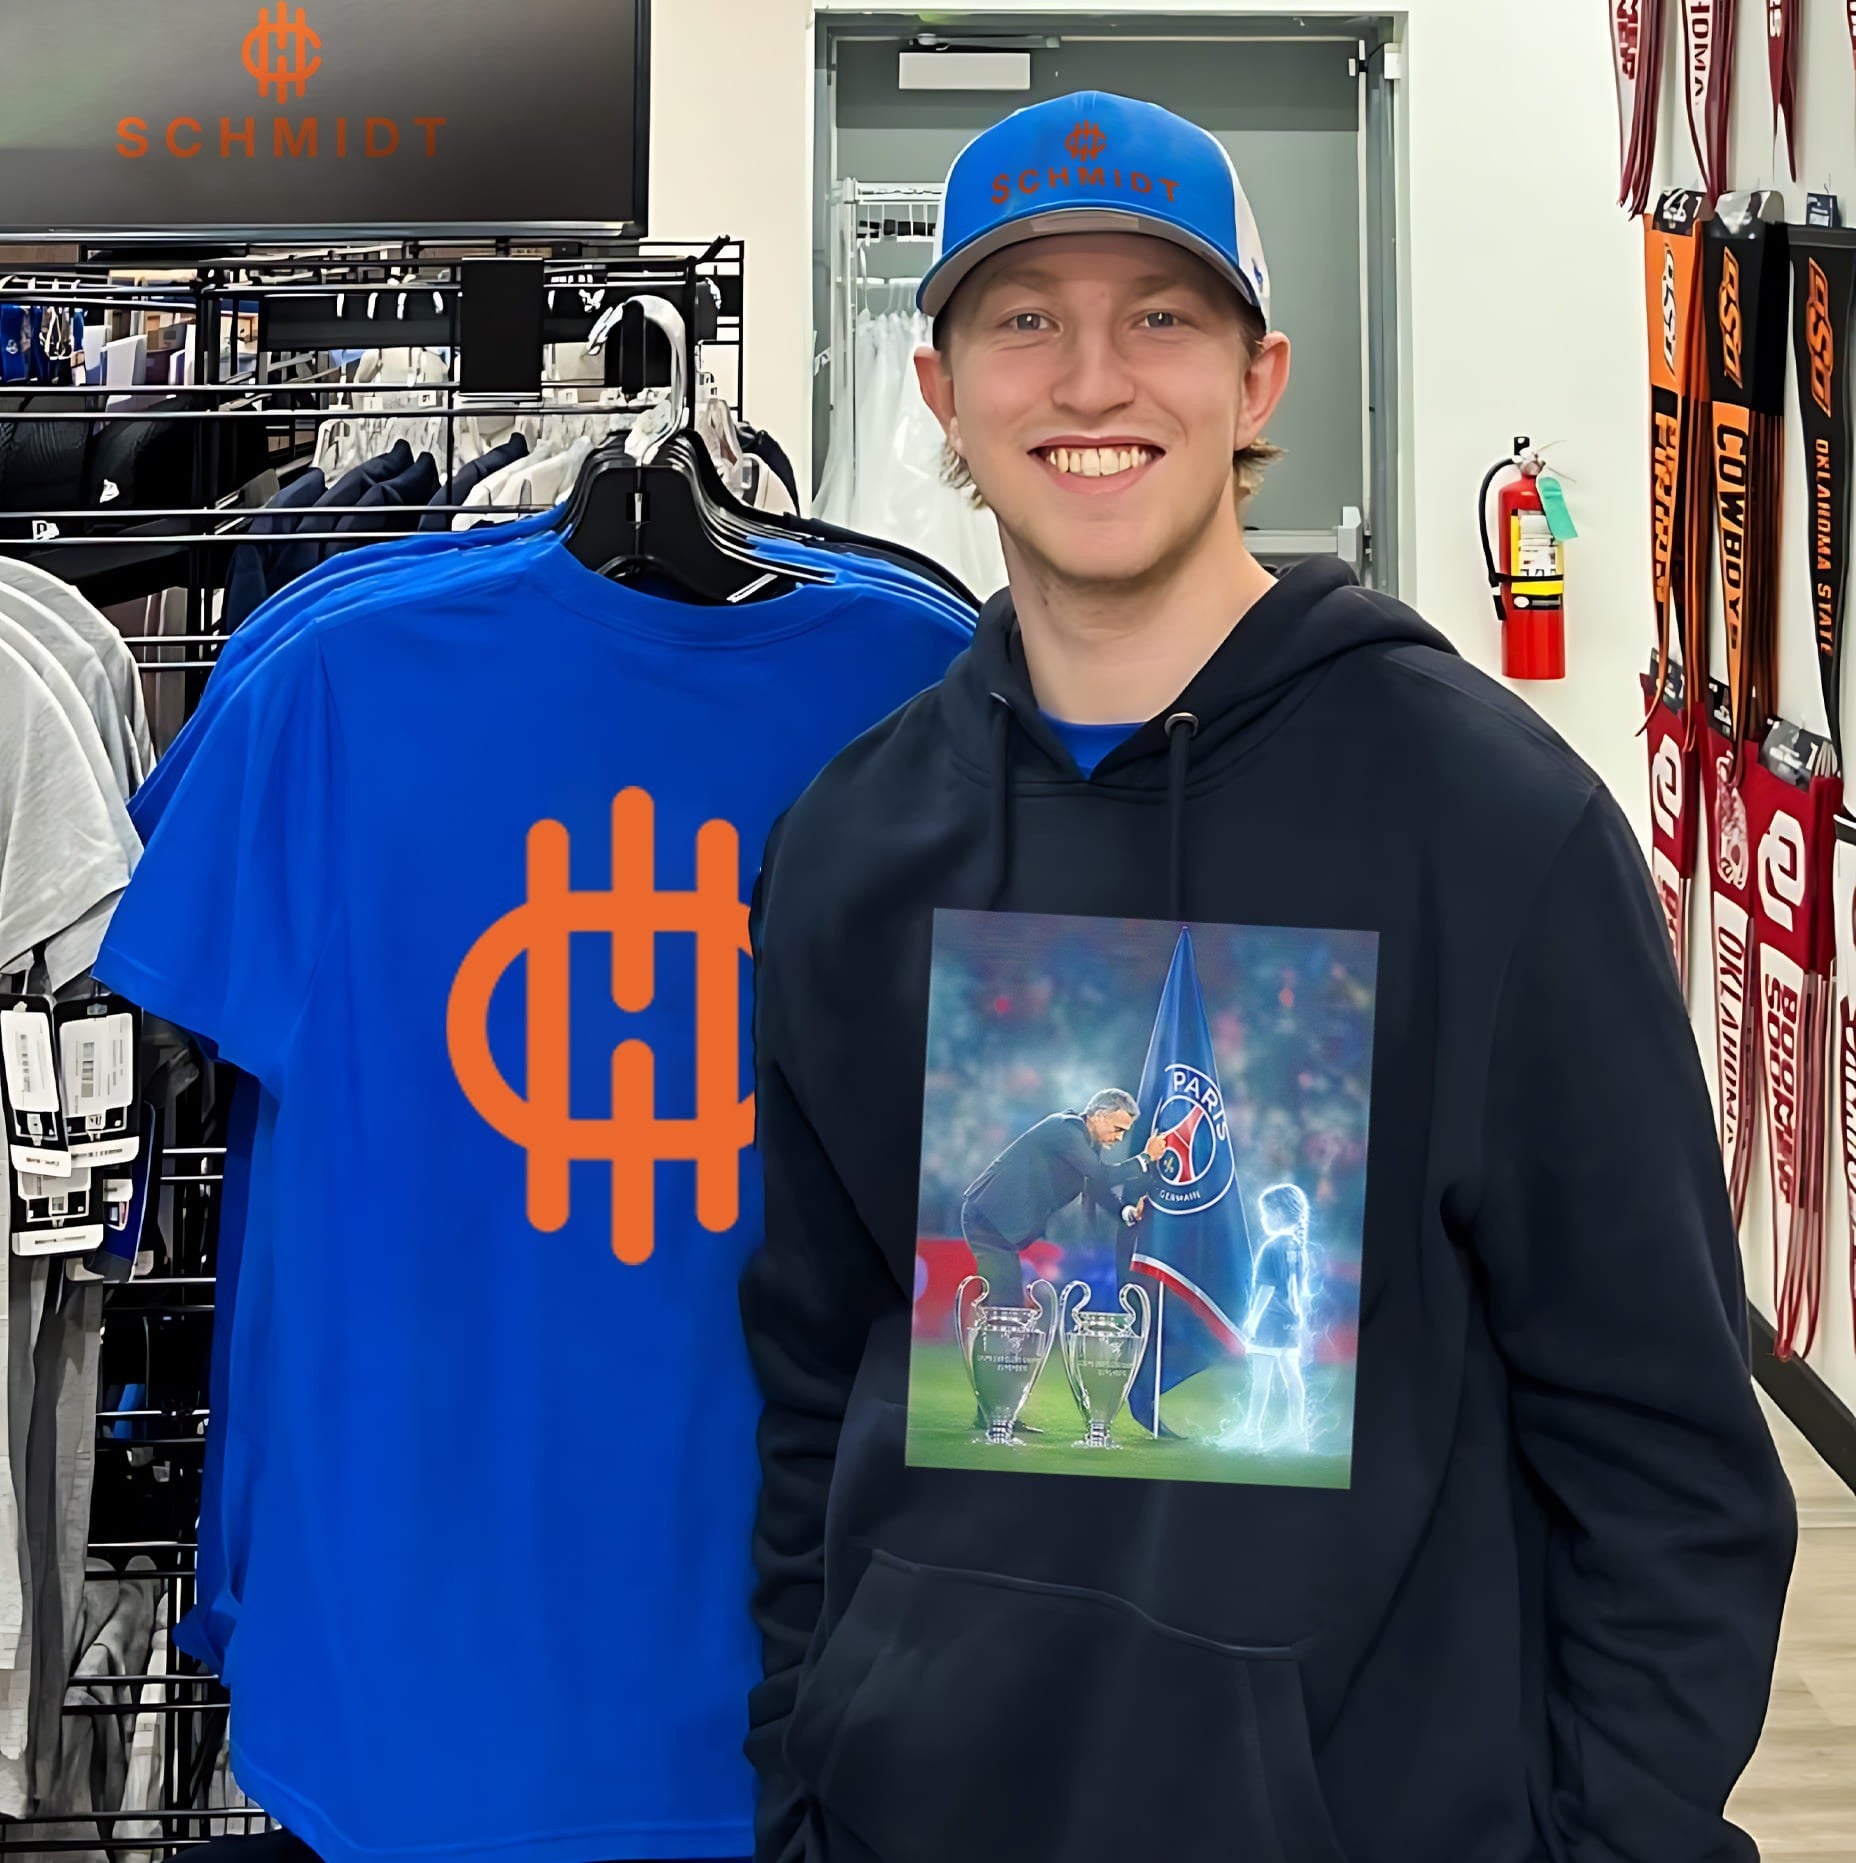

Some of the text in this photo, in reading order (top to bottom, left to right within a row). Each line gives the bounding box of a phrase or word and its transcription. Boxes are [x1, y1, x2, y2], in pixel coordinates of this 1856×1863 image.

[115, 115, 448, 159] SCHMIDT
[991, 166, 1180, 205] SCHMIDT
[1814, 438, 1832, 570] OKLAHOMA
[1718, 926, 1745, 1144] OKLAHOMA
[1173, 1071, 1227, 1141] PARIS
[1159, 1189, 1201, 1202] GERMAIN
